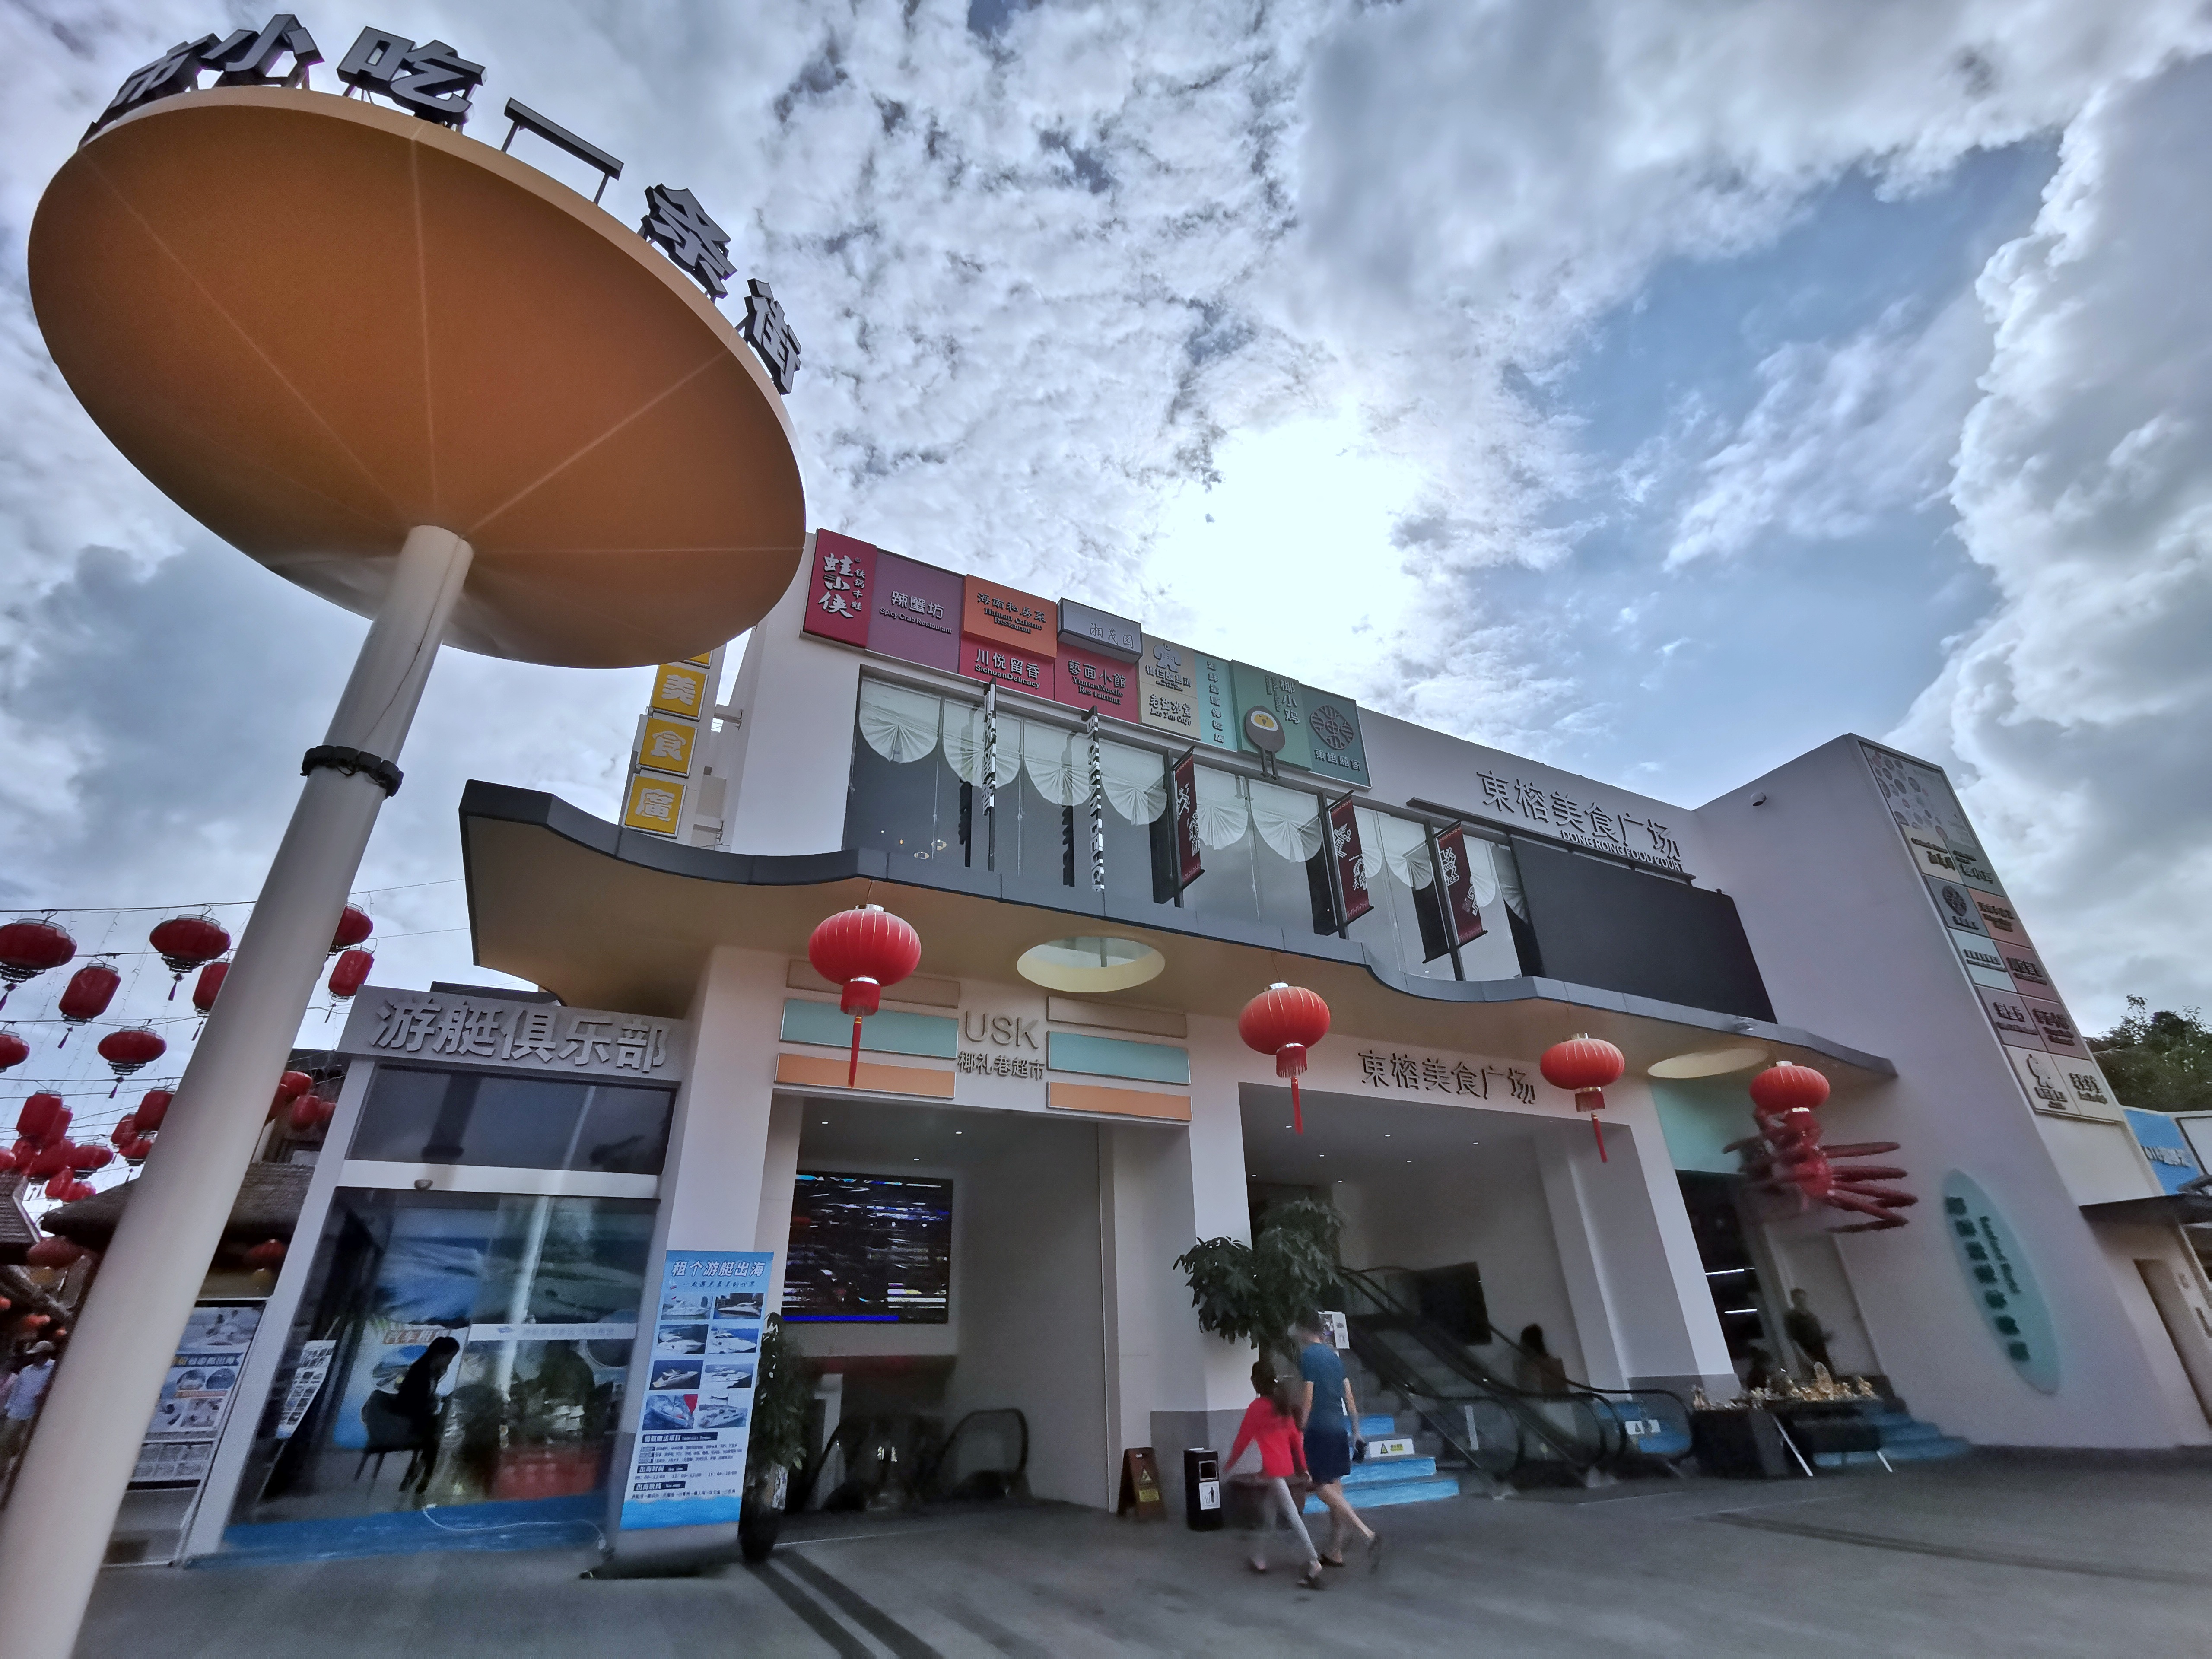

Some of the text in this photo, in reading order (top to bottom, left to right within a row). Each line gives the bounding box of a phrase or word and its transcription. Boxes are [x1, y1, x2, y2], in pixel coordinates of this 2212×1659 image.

[818, 553, 854, 618] 蛙小侠
[891, 590, 944, 619] 辣蟹坊
[880, 607, 952, 634] Spicy Crab Restaurant
[977, 592, 1046, 623] 海南私房菜
[975, 648, 1039, 680] 川悦留香
[1068, 660, 1126, 689] 藝面小館
[1280, 679, 1300, 725] 椰小鸡
[1476, 770, 1681, 861] 東榕美食广场
[1560, 830, 1683, 872] DONG RONG FOOD COURT
[371, 997, 669, 1073] 游艇俱乐部
[965, 1010, 1039, 1049] USK
[1357, 1049, 1536, 1104] 東榕美食广场
[671, 1260, 766, 1277] 租个游艇出海
